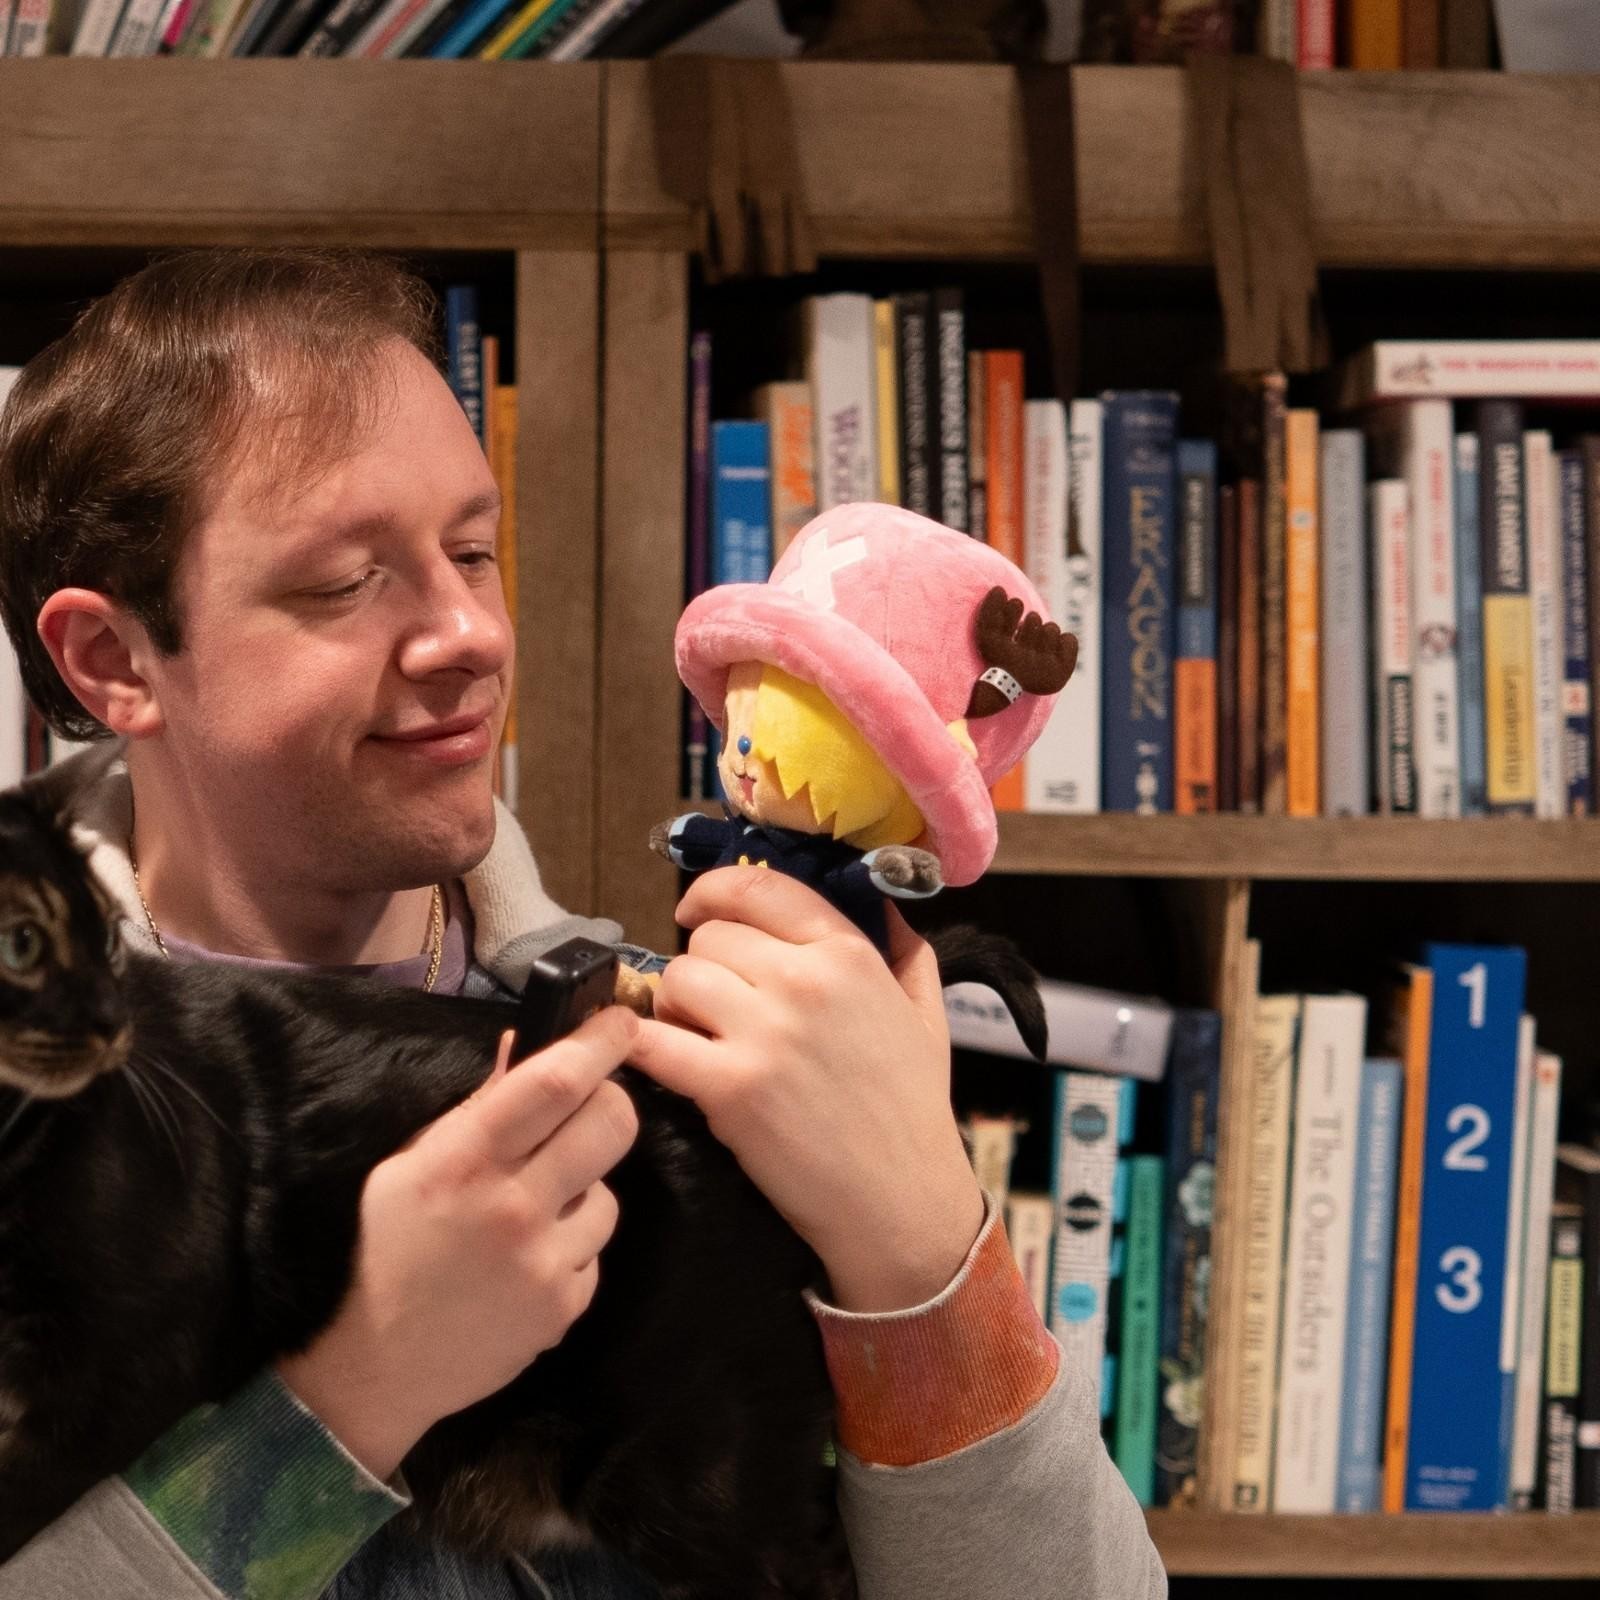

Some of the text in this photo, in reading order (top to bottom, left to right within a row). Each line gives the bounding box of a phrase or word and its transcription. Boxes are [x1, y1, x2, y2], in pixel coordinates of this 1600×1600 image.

[938, 310, 966, 529] INGENIOUS MECH
[1494, 445, 1523, 590] DAVE RAMSEY
[1128, 485, 1169, 721] ERAGON
[1459, 963, 1487, 1029] 1
[1309, 1109, 1345, 1184] The
[1443, 1102, 1491, 1172] 2
[1295, 1193, 1341, 1376] Outsiders
[1435, 1244, 1483, 1314] 3
